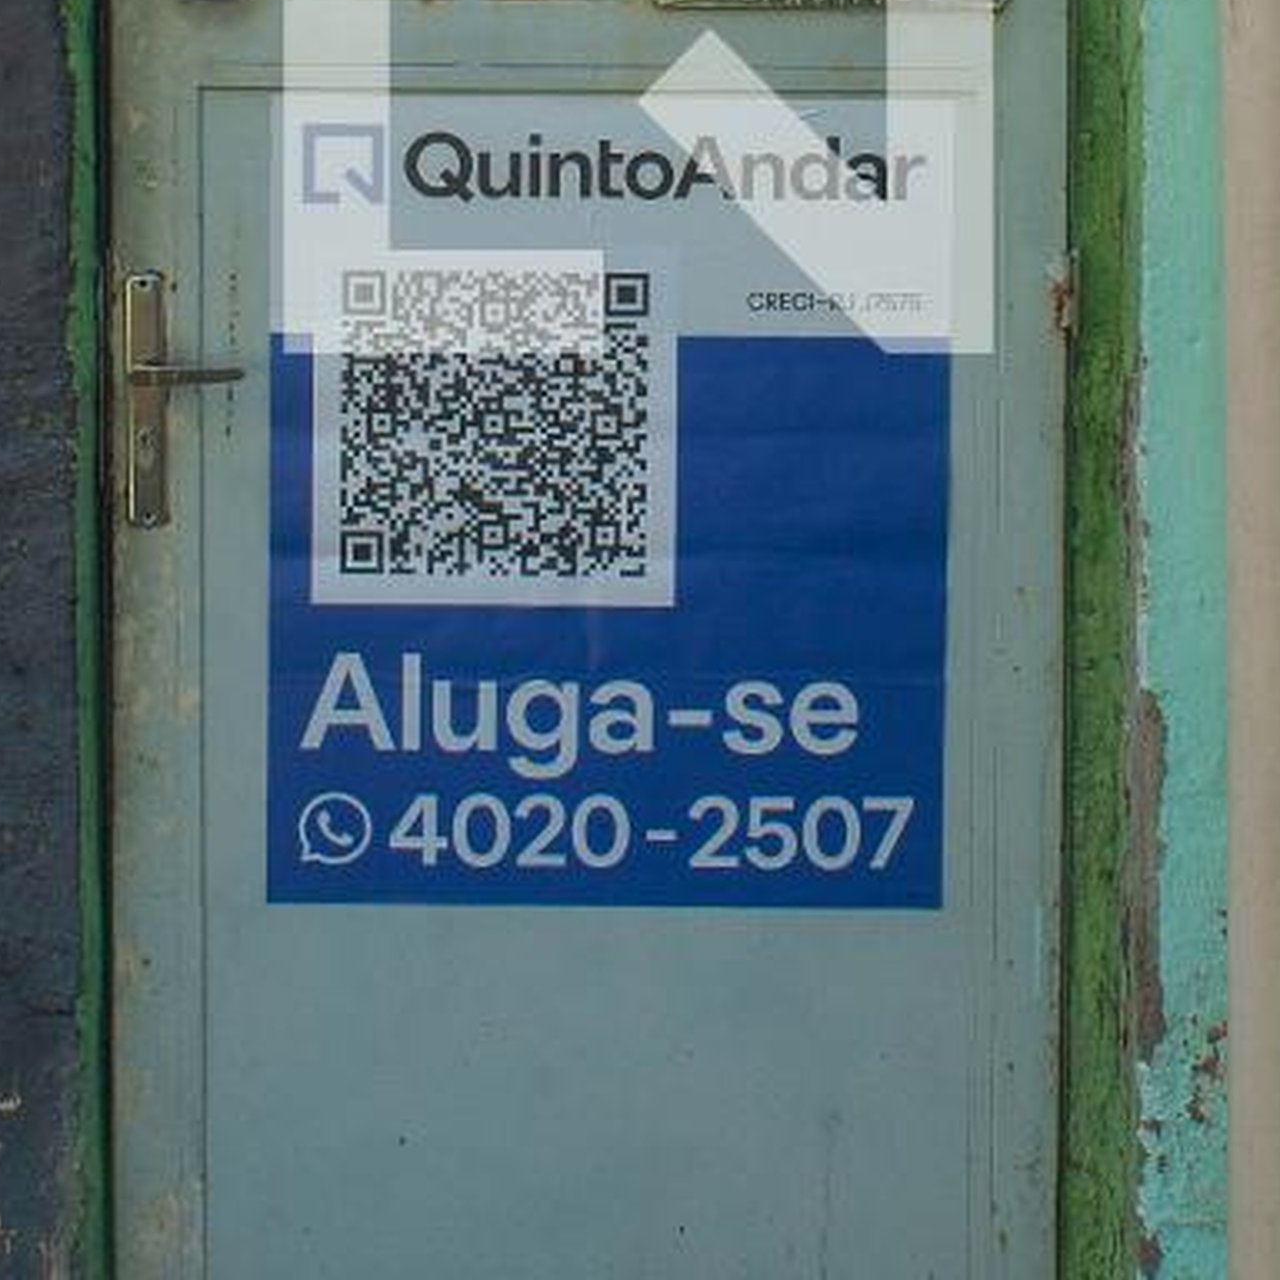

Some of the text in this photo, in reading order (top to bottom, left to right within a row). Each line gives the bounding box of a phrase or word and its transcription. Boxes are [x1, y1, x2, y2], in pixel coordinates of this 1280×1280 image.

[403, 132, 926, 203] QuintoAndar
[300, 652, 859, 779] Aluga-se
[389, 793, 914, 871] 4020-2507
